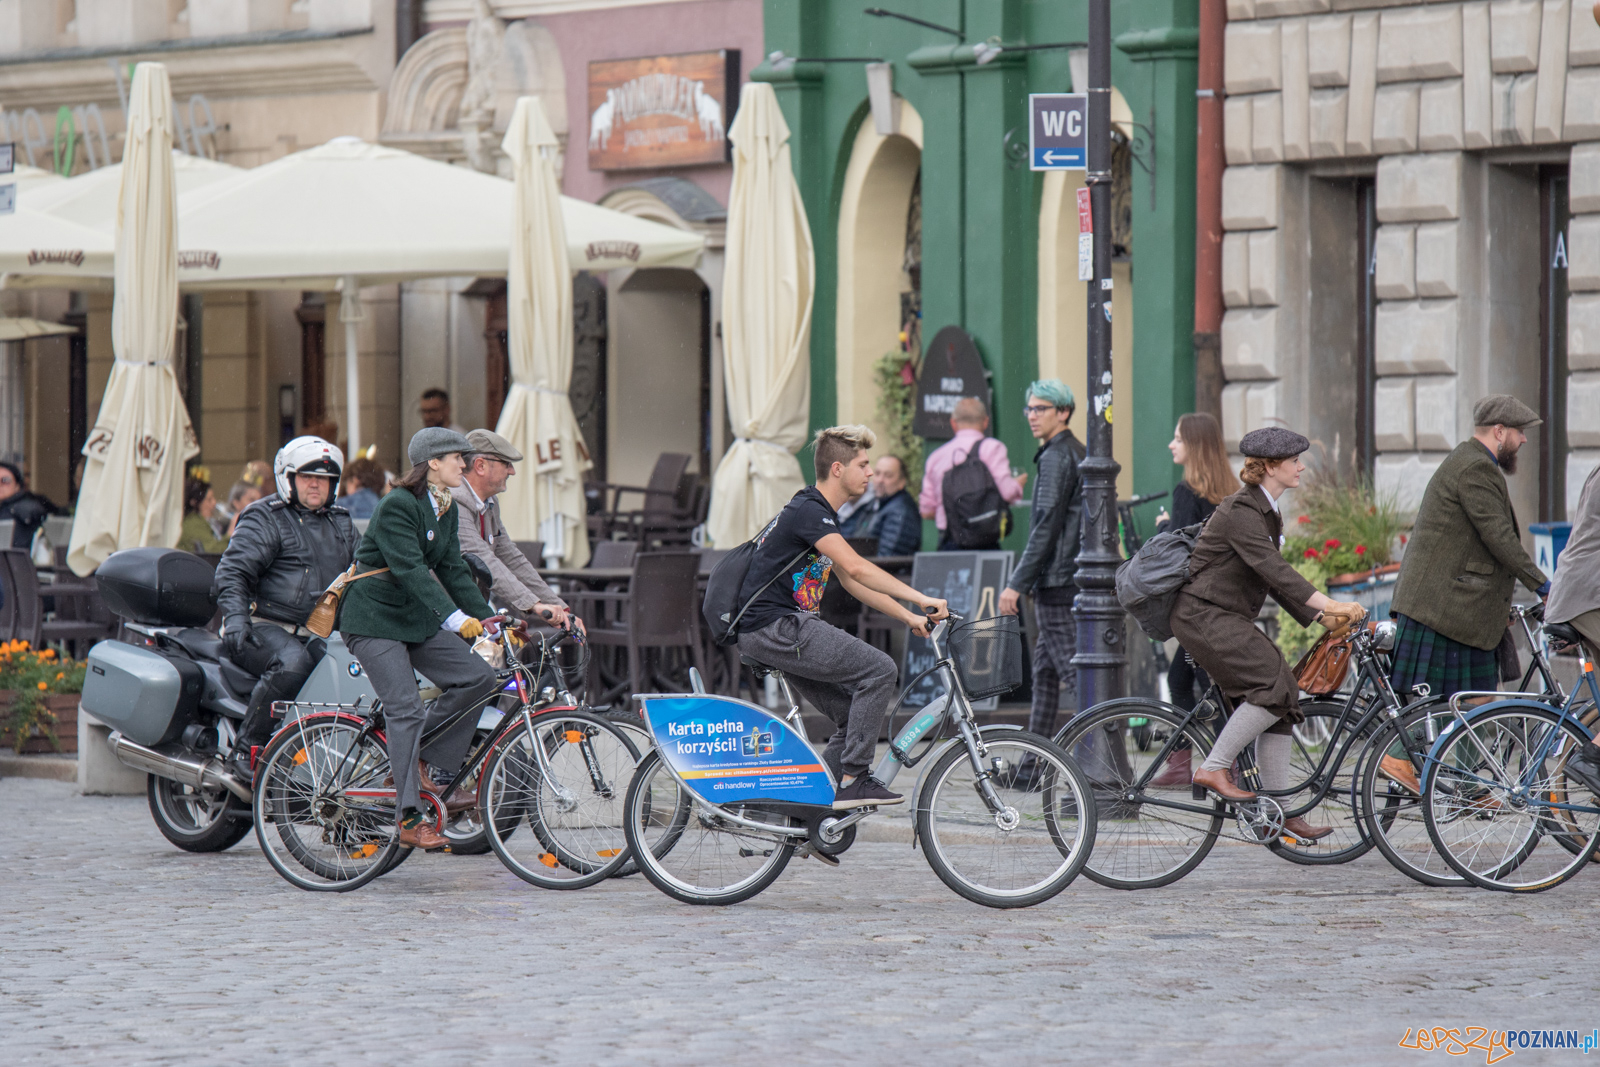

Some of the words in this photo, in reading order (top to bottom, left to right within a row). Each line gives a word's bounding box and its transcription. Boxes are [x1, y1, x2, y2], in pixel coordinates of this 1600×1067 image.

[1041, 110, 1082, 137] WC
[668, 721, 704, 736] Karta
[707, 719, 744, 737] pełna
[677, 737, 737, 756] korzyści!
[713, 781, 725, 790] citi
